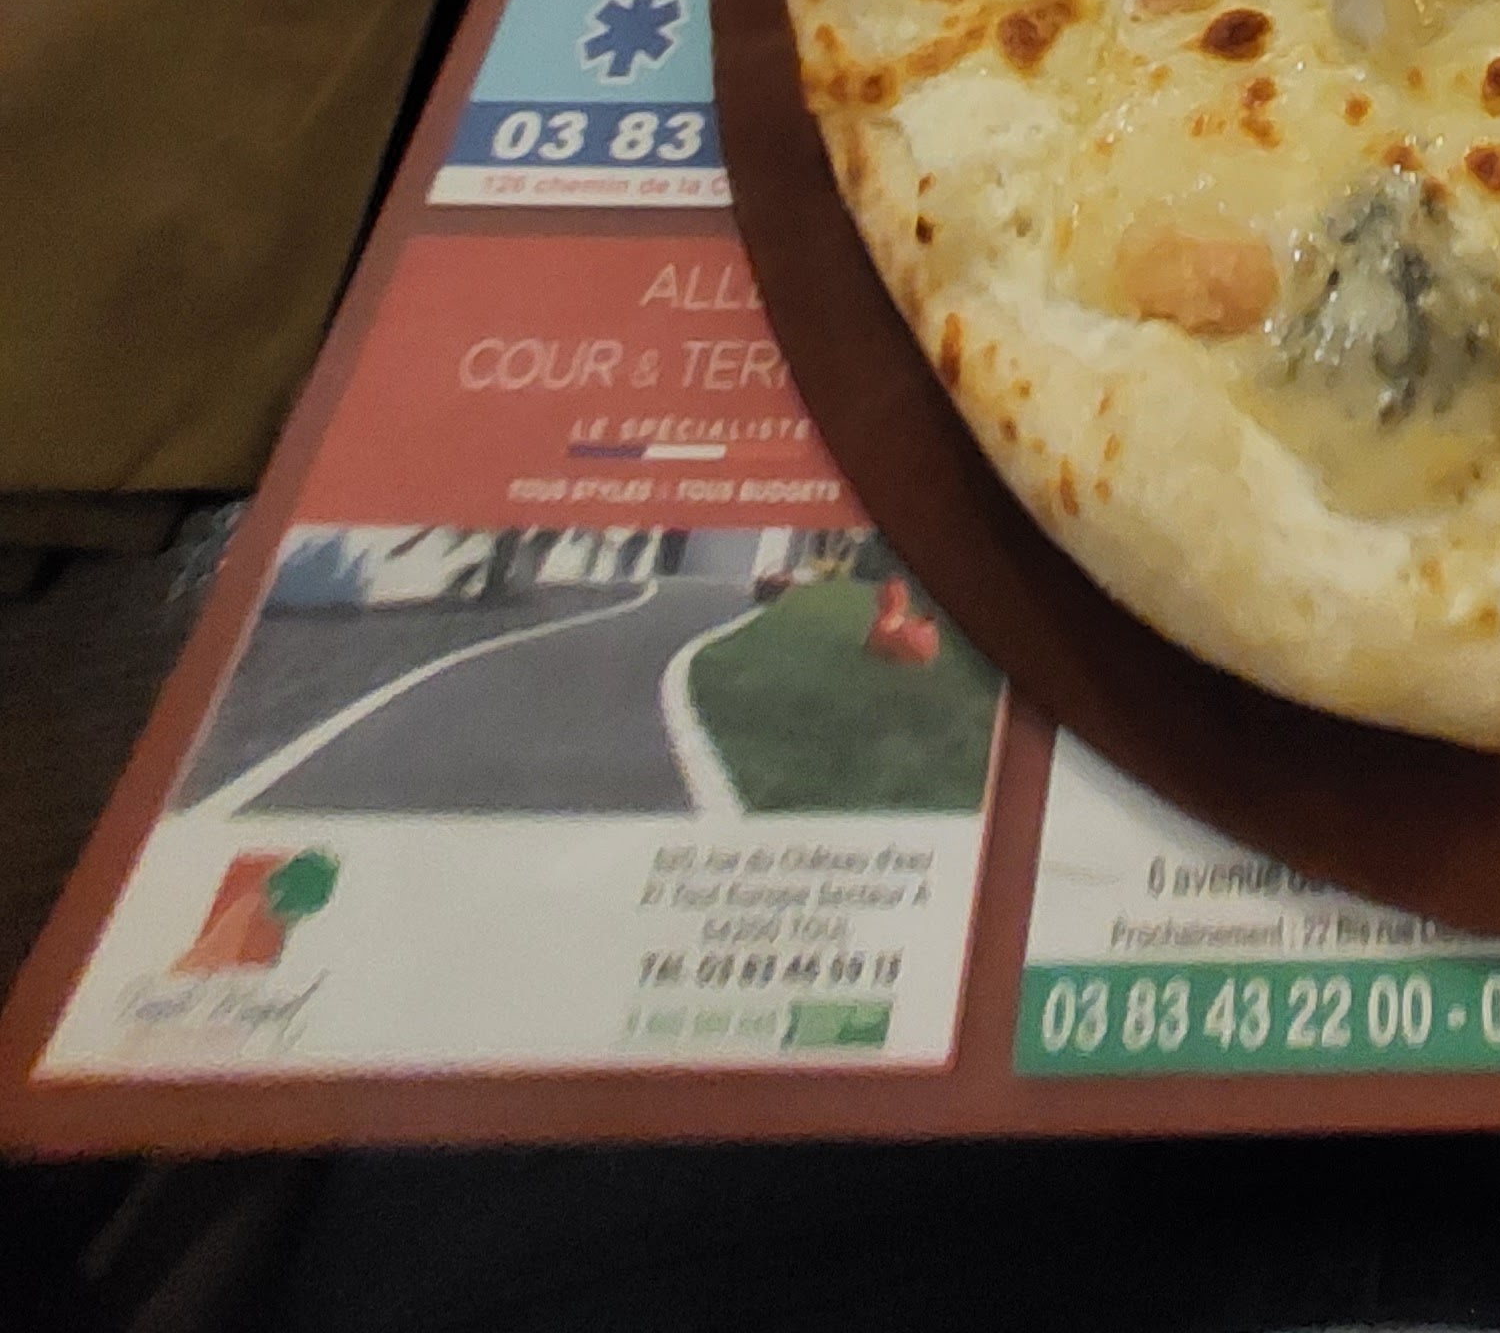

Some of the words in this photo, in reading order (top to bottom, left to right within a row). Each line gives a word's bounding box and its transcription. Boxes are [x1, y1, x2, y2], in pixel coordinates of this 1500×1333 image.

[491, 109, 589, 161] 03
[608, 110, 706, 162] 83
[459, 337, 624, 390] COUR
[629, 347, 662, 390] &
[1041, 976, 1112, 1054] 03
[1120, 974, 1193, 1054] 83
[1204, 975, 1272, 1053] 43
[1286, 973, 1353, 1051] 22
[1367, 972, 1433, 1050] 00
